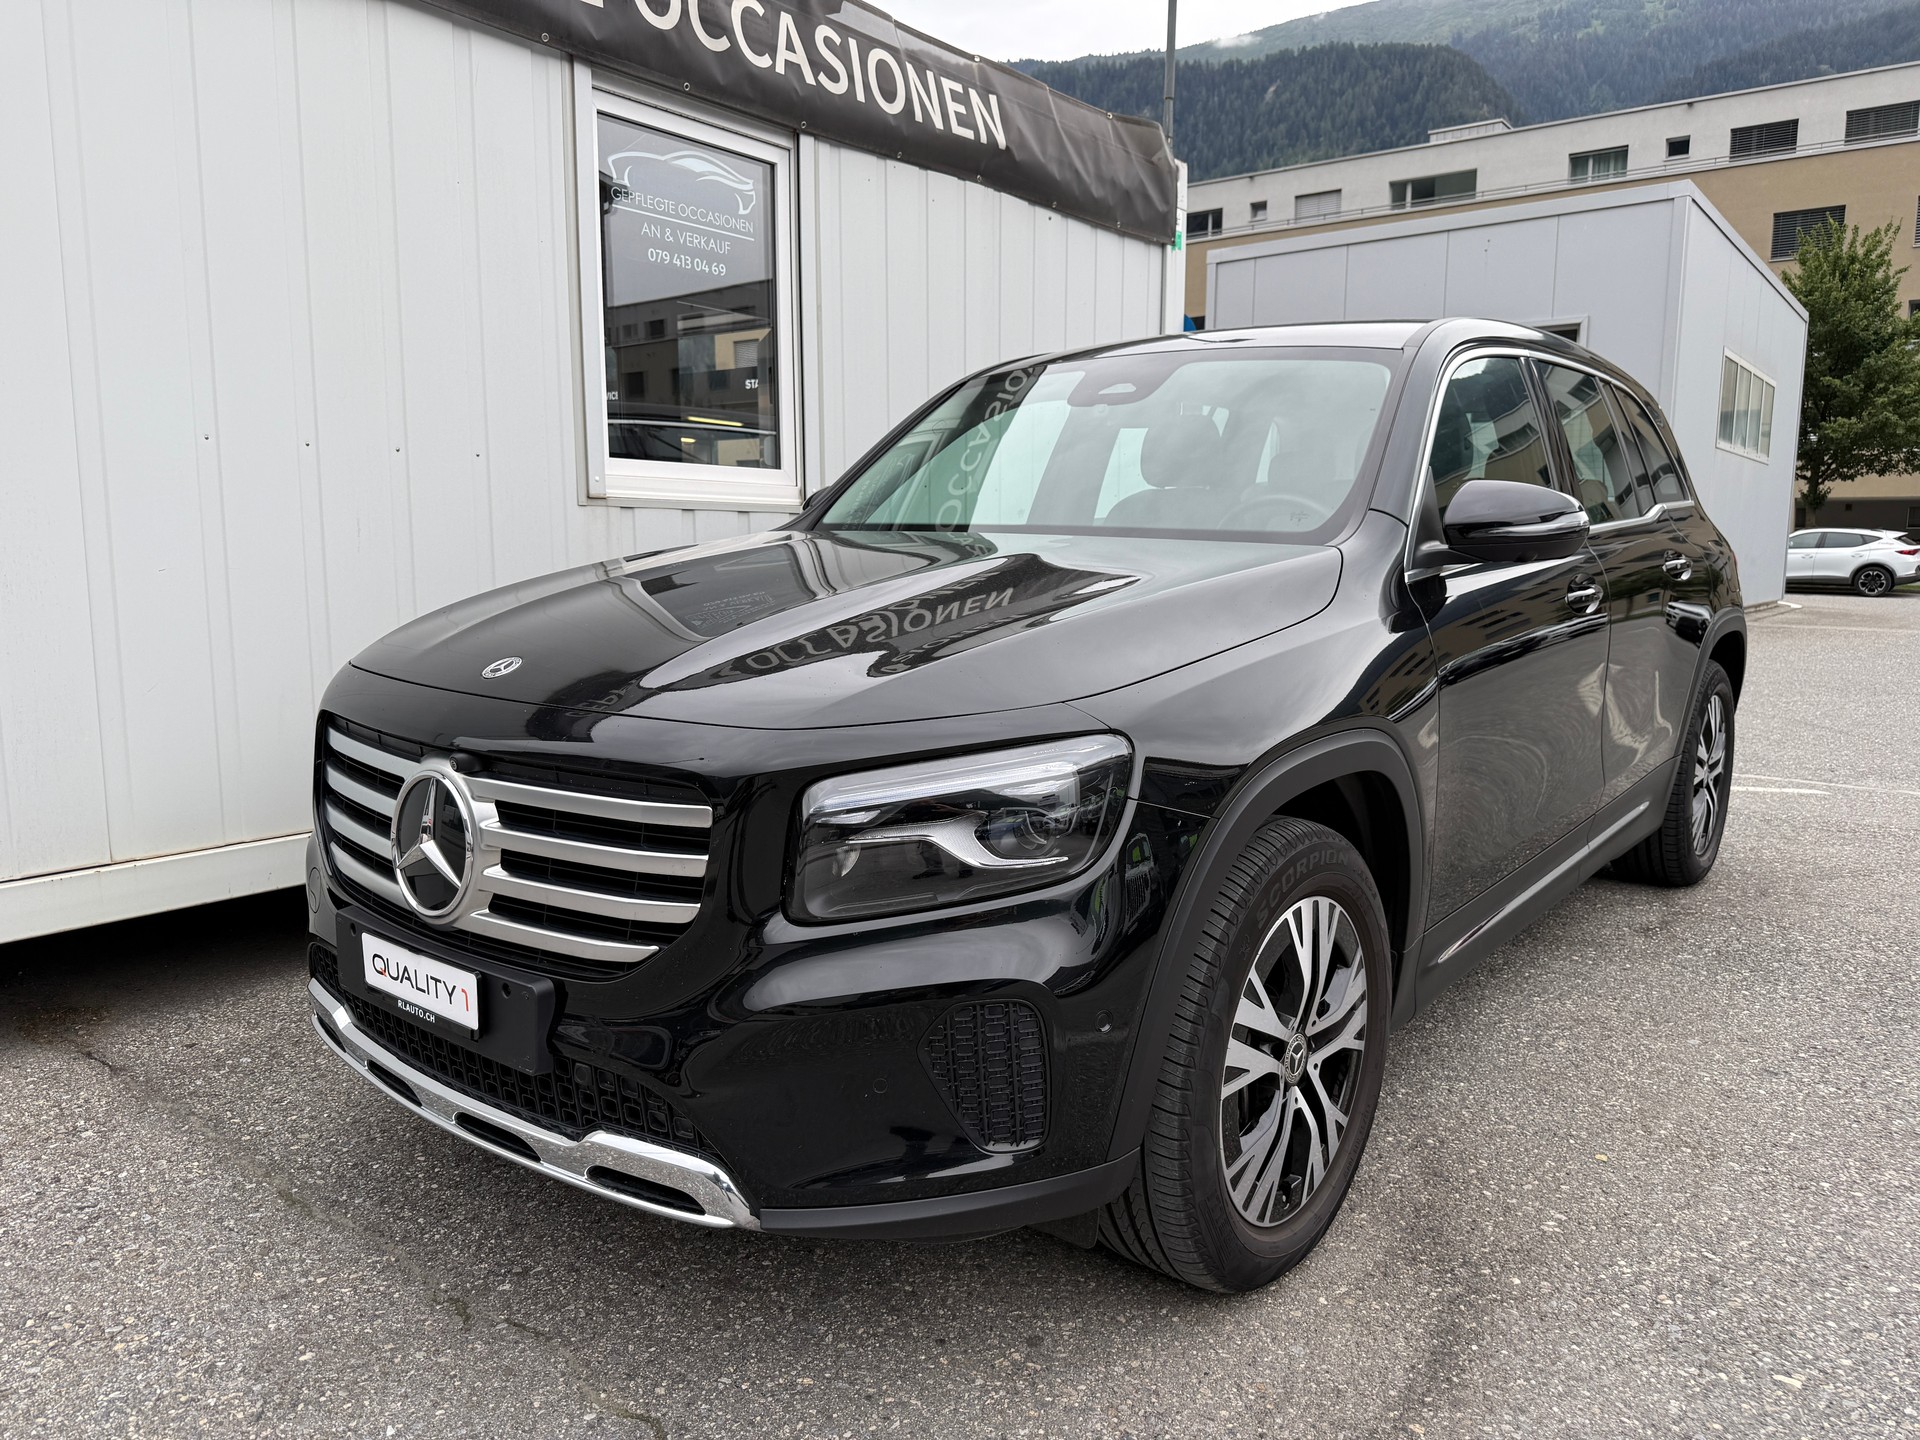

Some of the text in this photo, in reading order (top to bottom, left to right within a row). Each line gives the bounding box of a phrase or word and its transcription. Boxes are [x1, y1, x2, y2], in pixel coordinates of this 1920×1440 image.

[610, 186, 754, 233] GEPFLEGTE OCCASIONEN
[641, 222, 731, 255] AN & VERKAUF
[648, 248, 726, 276] 079 413 04 69
[1257, 850, 1350, 930] SCORPION
[397, 999, 436, 1023] RLAUTO.CH
